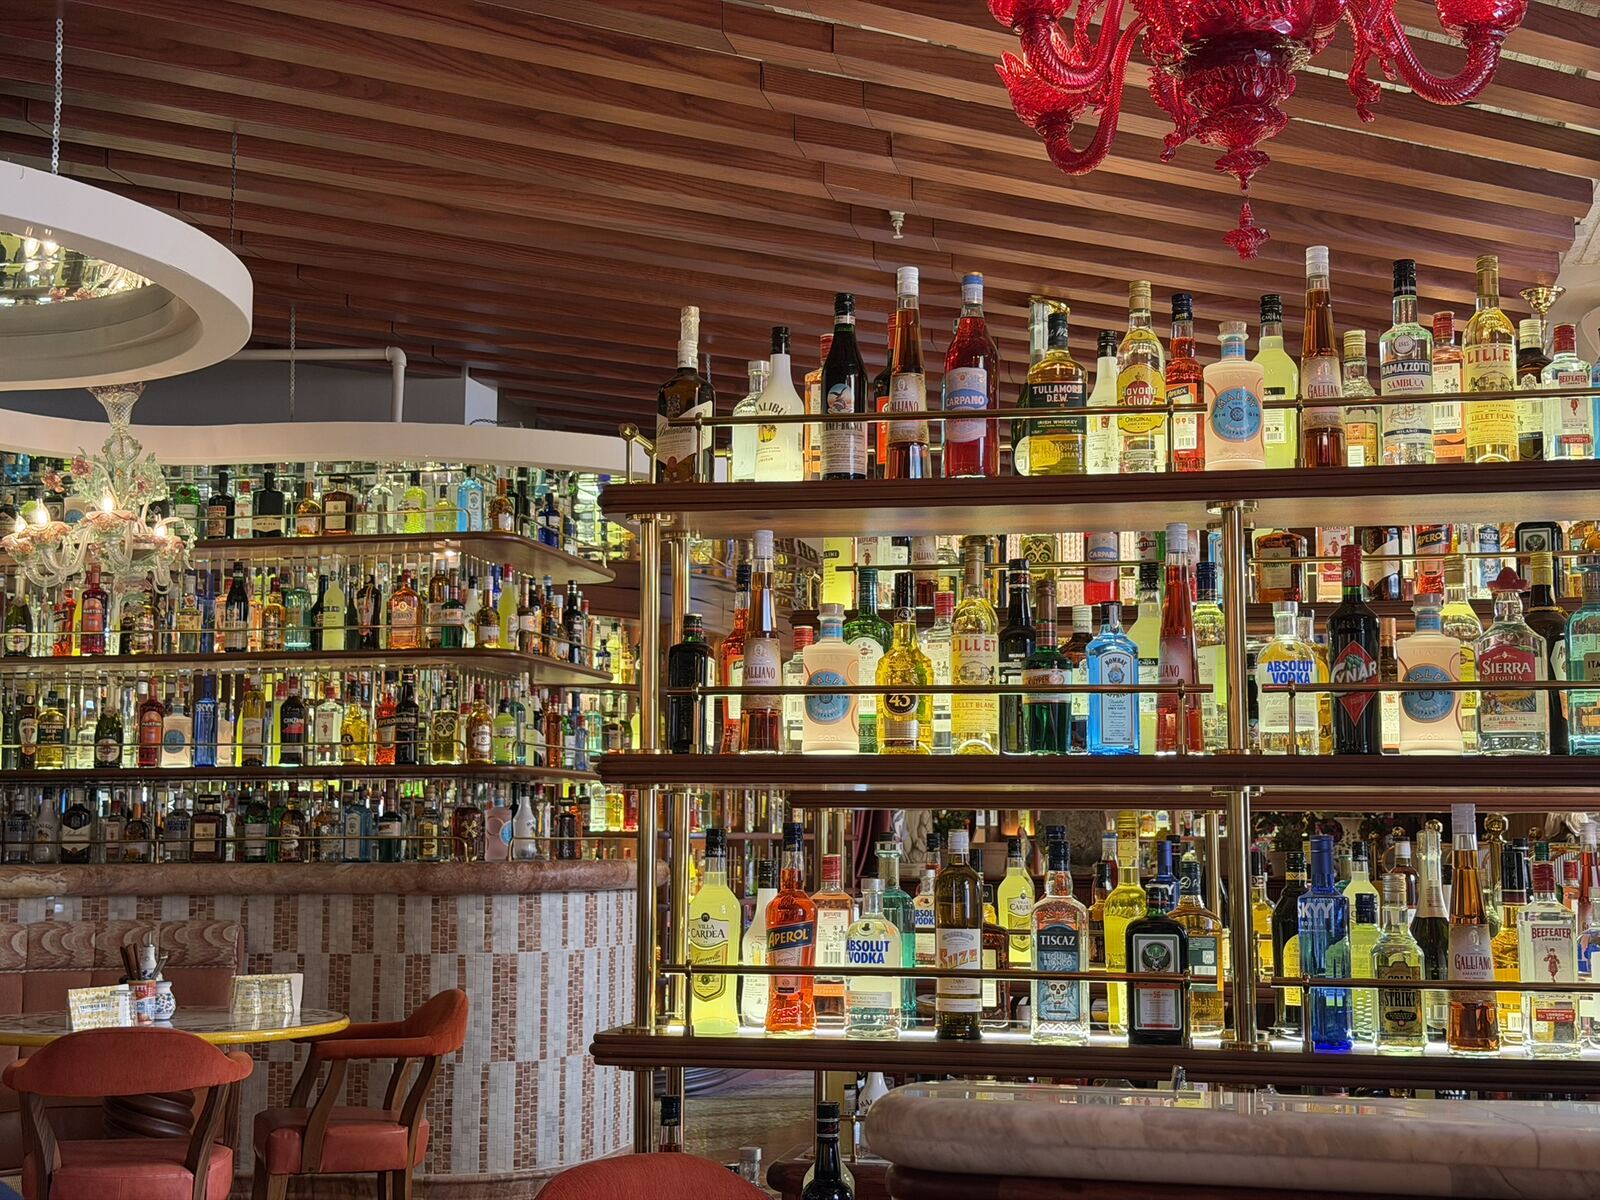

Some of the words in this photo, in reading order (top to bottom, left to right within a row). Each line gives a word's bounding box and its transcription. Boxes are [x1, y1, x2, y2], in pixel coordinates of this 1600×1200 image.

[1466, 348, 1513, 364] LILLE
[1386, 379, 1425, 389] SAMBUCA
[1558, 374, 1587, 384] BEEFEATER
[1032, 384, 1083, 395] TULLAMORE
[945, 395, 986, 407] CARPANO
[1417, 530, 1447, 546] APEROL
[1088, 551, 1117, 559] CARPANO
[1267, 660, 1313, 673] ABSOLUT
[1481, 658, 1533, 676] SIERRA
[1272, 673, 1311, 685] VODKA
[1298, 902, 1333, 919] SKYY
[698, 923, 715, 931] VILLA
[914, 917, 935, 926] VODK
[690, 927, 726, 942] CARDEA
[768, 927, 809, 948] APEROL
[1531, 927, 1572, 940] BEEFEATER
[1040, 935, 1076, 947] TISCAZ
[848, 952, 885, 965] VODKA
[1043, 952, 1073, 961] TEQUILA
[1454, 953, 1492, 971] GALLIANO
